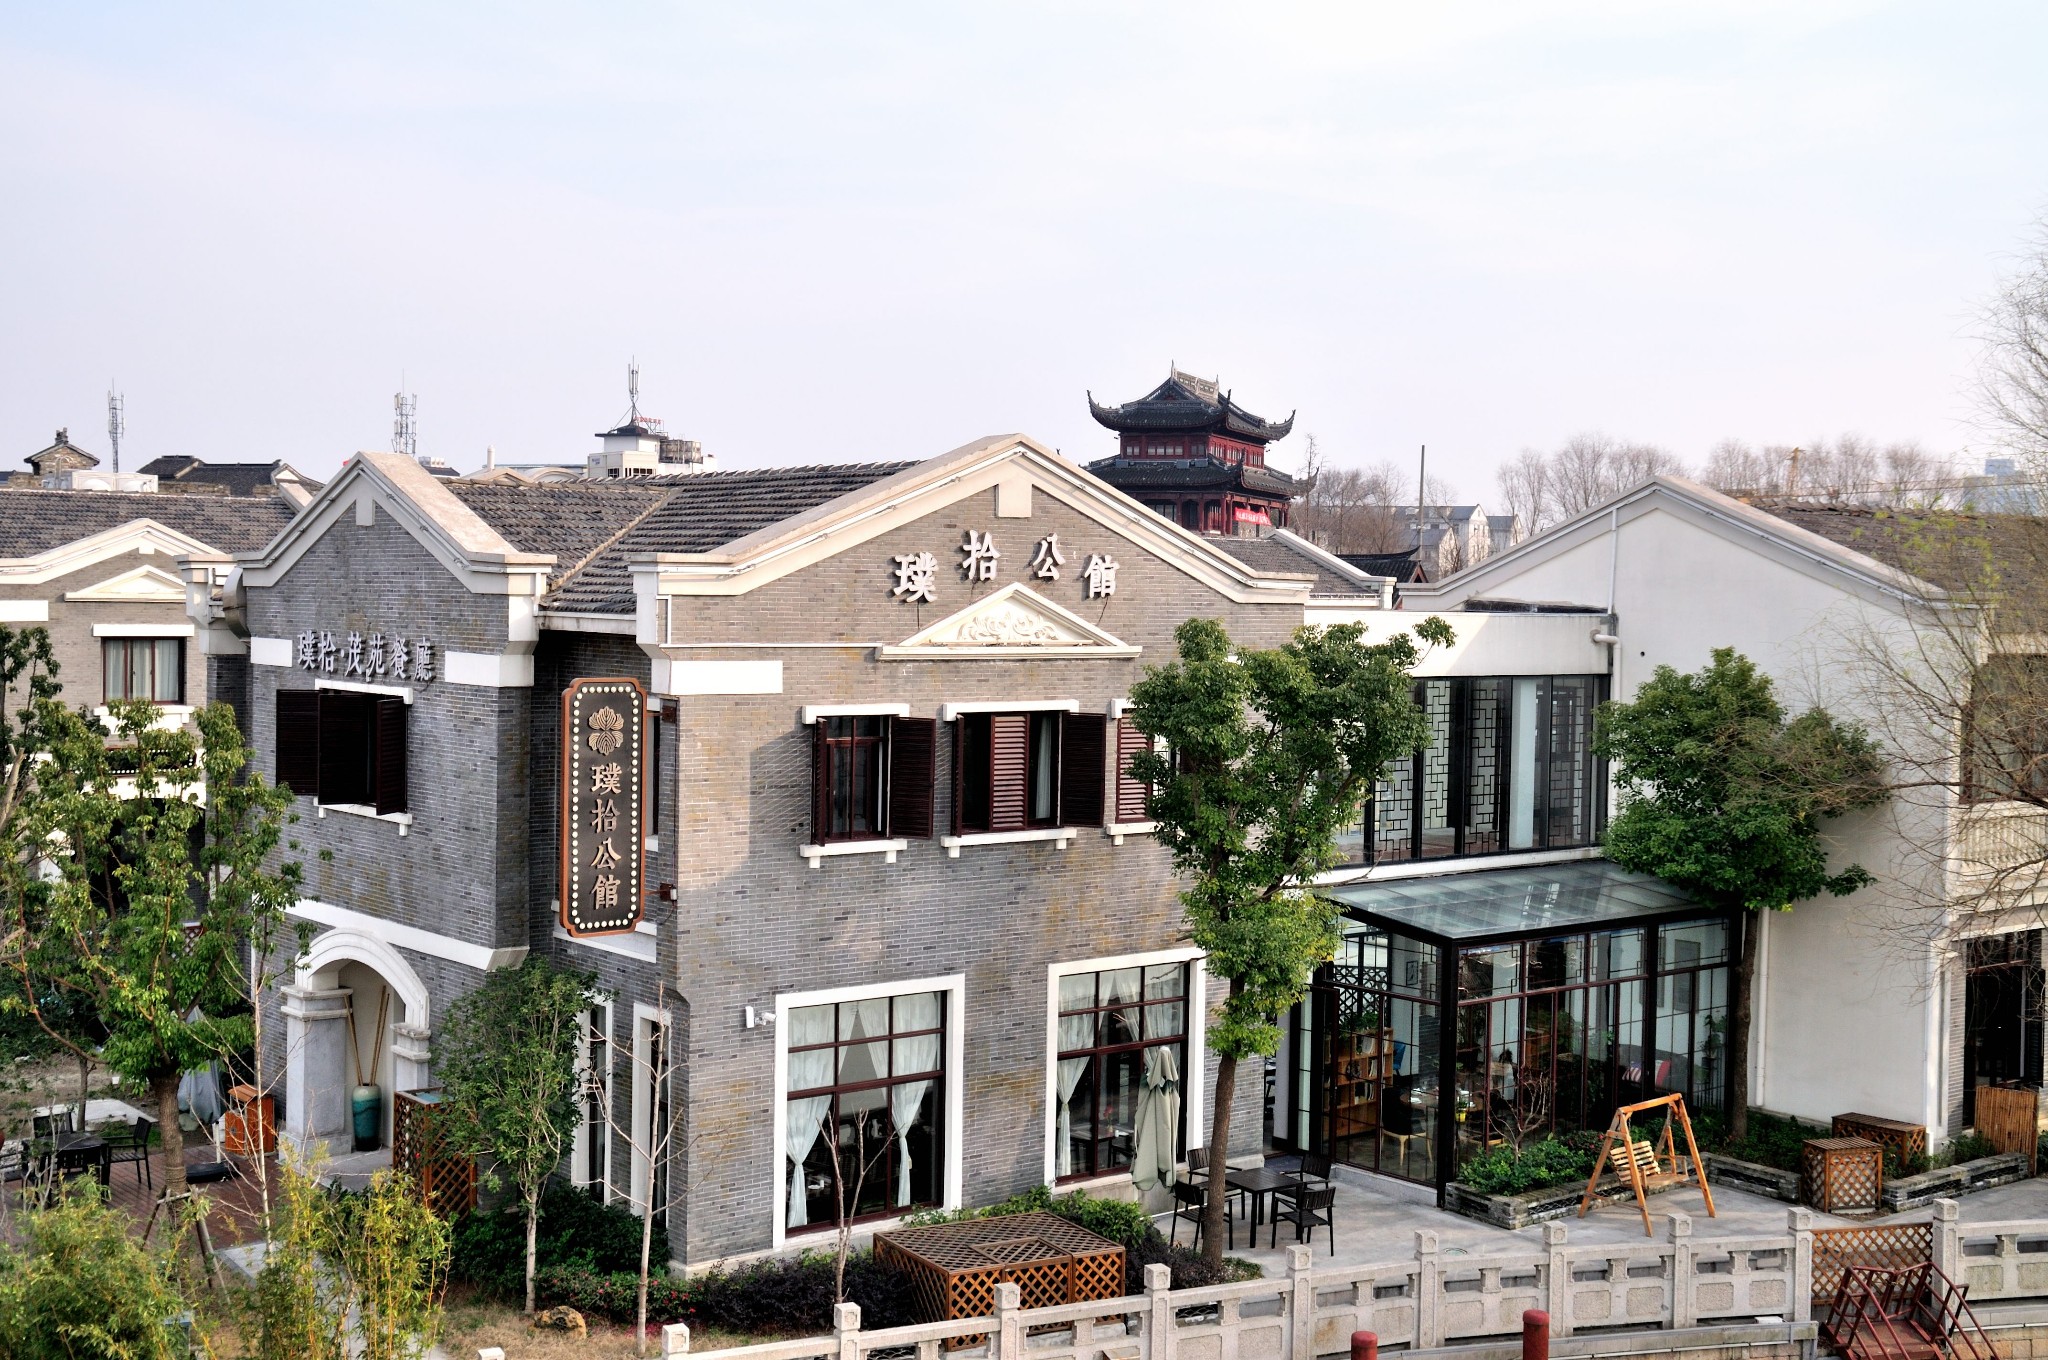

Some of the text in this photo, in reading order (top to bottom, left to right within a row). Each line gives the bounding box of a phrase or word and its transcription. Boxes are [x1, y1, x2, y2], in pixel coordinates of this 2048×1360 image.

[893, 529, 1121, 602] 璞拾公館
[590, 762, 622, 910] 璞拾公館
